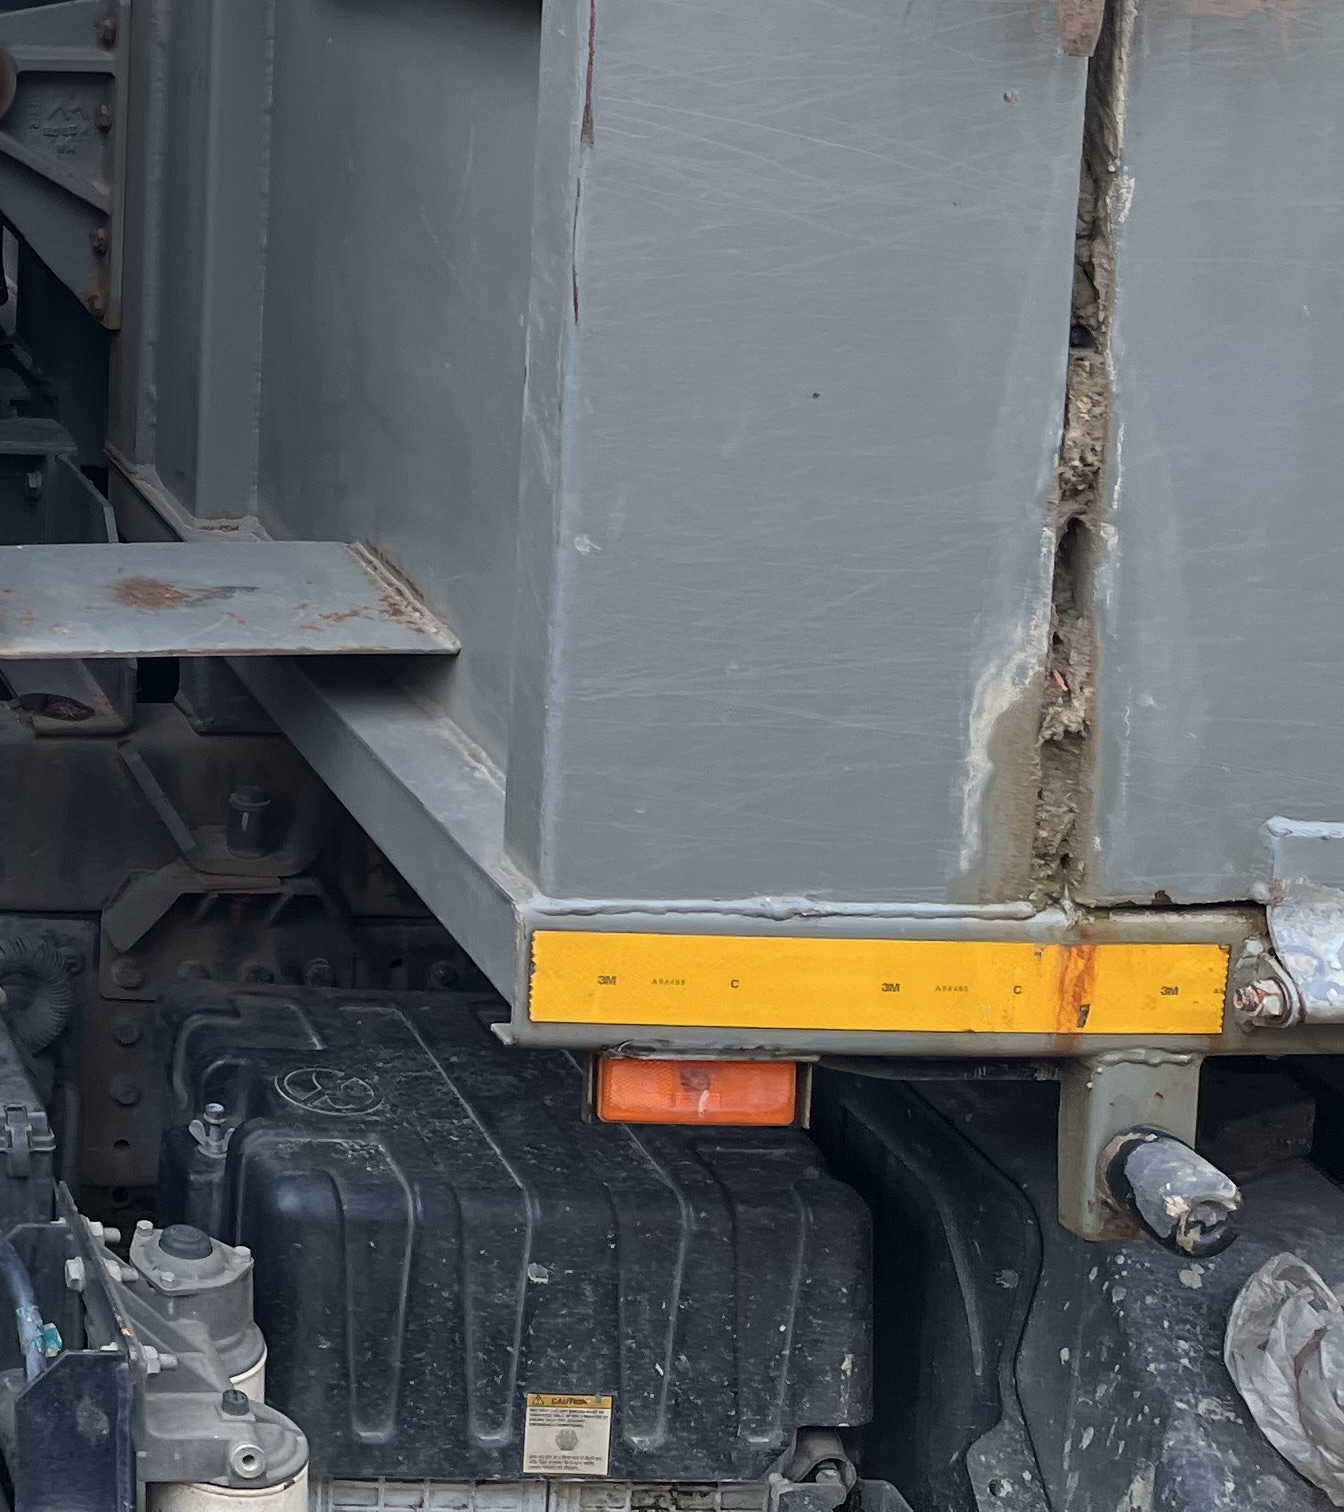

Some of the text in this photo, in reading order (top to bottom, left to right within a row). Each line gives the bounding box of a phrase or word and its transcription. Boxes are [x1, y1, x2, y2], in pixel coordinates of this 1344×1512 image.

[597, 975, 617, 986] 3M
[730, 979, 740, 989] C
[881, 983, 901, 993] 3M
[1013, 985, 1023, 995] C
[1160, 985, 1180, 996] 3M
[551, 1397, 588, 1406] CAUTION
